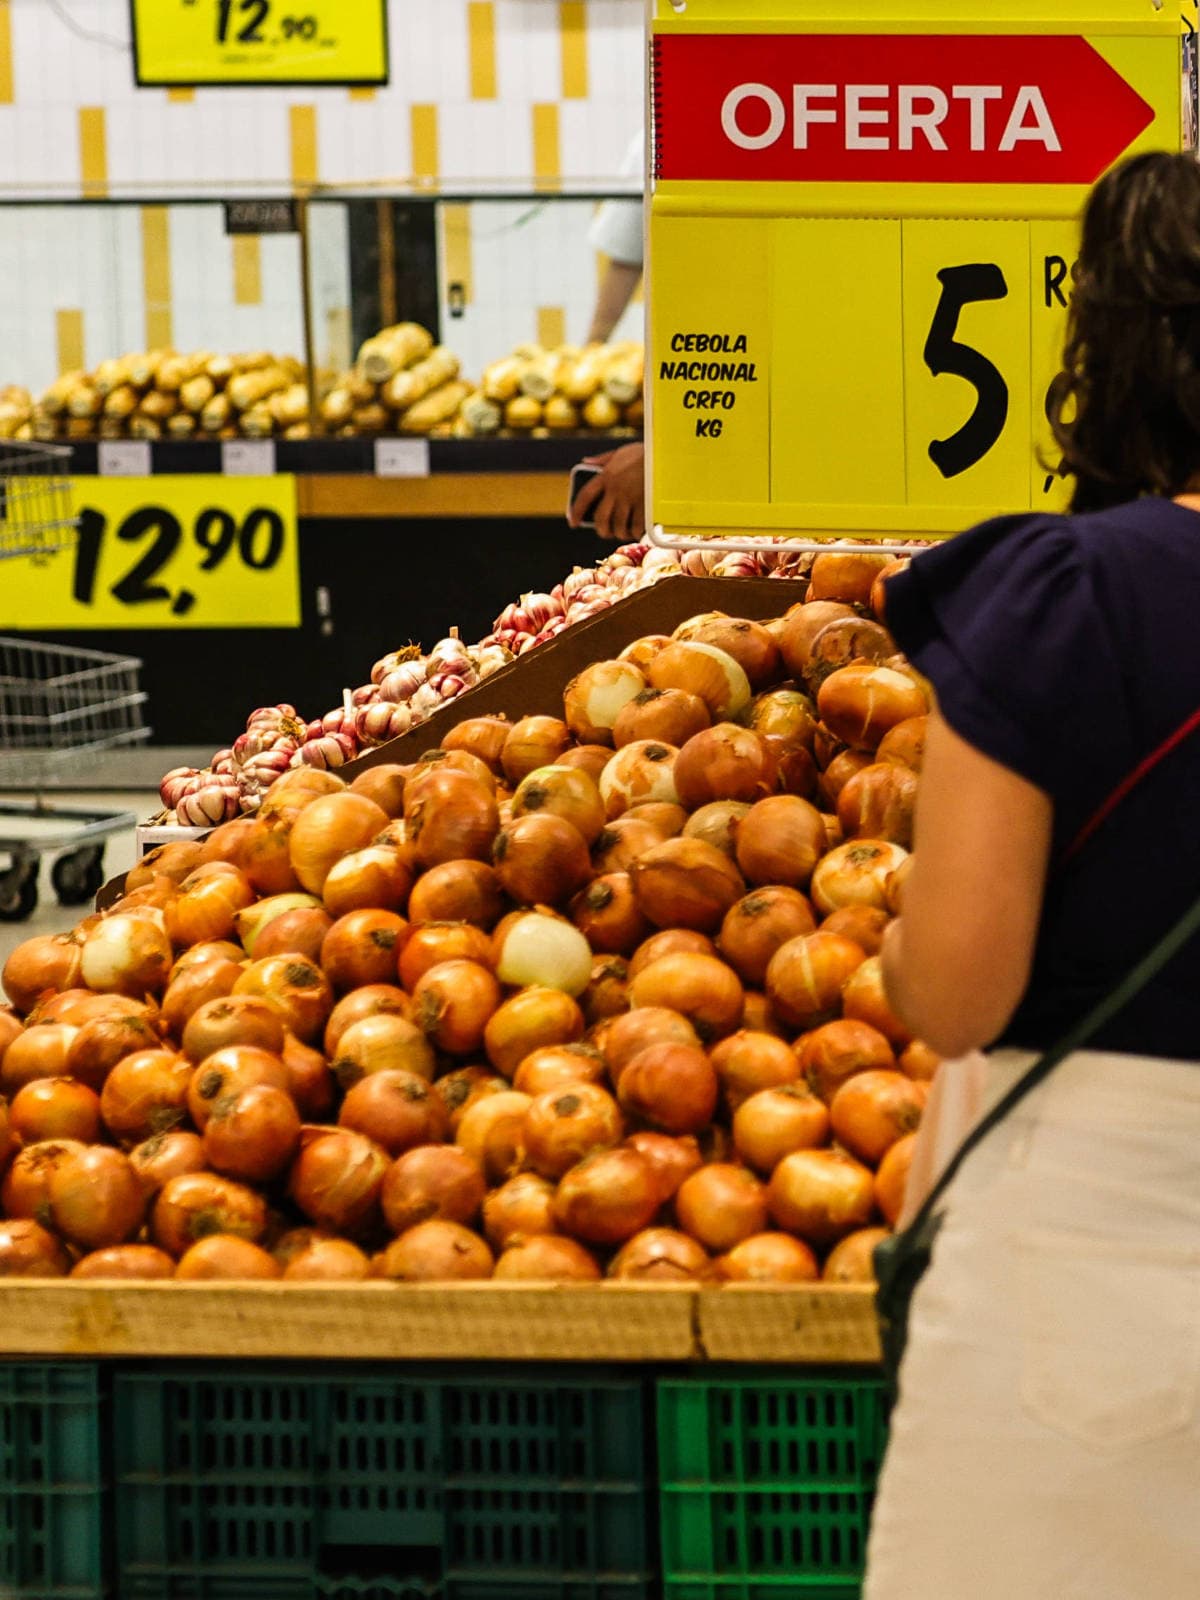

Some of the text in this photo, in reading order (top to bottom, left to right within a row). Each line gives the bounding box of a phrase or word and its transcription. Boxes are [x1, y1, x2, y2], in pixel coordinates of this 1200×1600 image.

[720, 82, 1062, 152] OFERTA
[671, 333, 747, 353] CEBOLA
[660, 361, 758, 382] NACIONAL
[923, 263, 1008, 479] 5
[682, 390, 736, 410] CRFO
[695, 418, 723, 438] KG
[73, 505, 285, 616] 12,90
